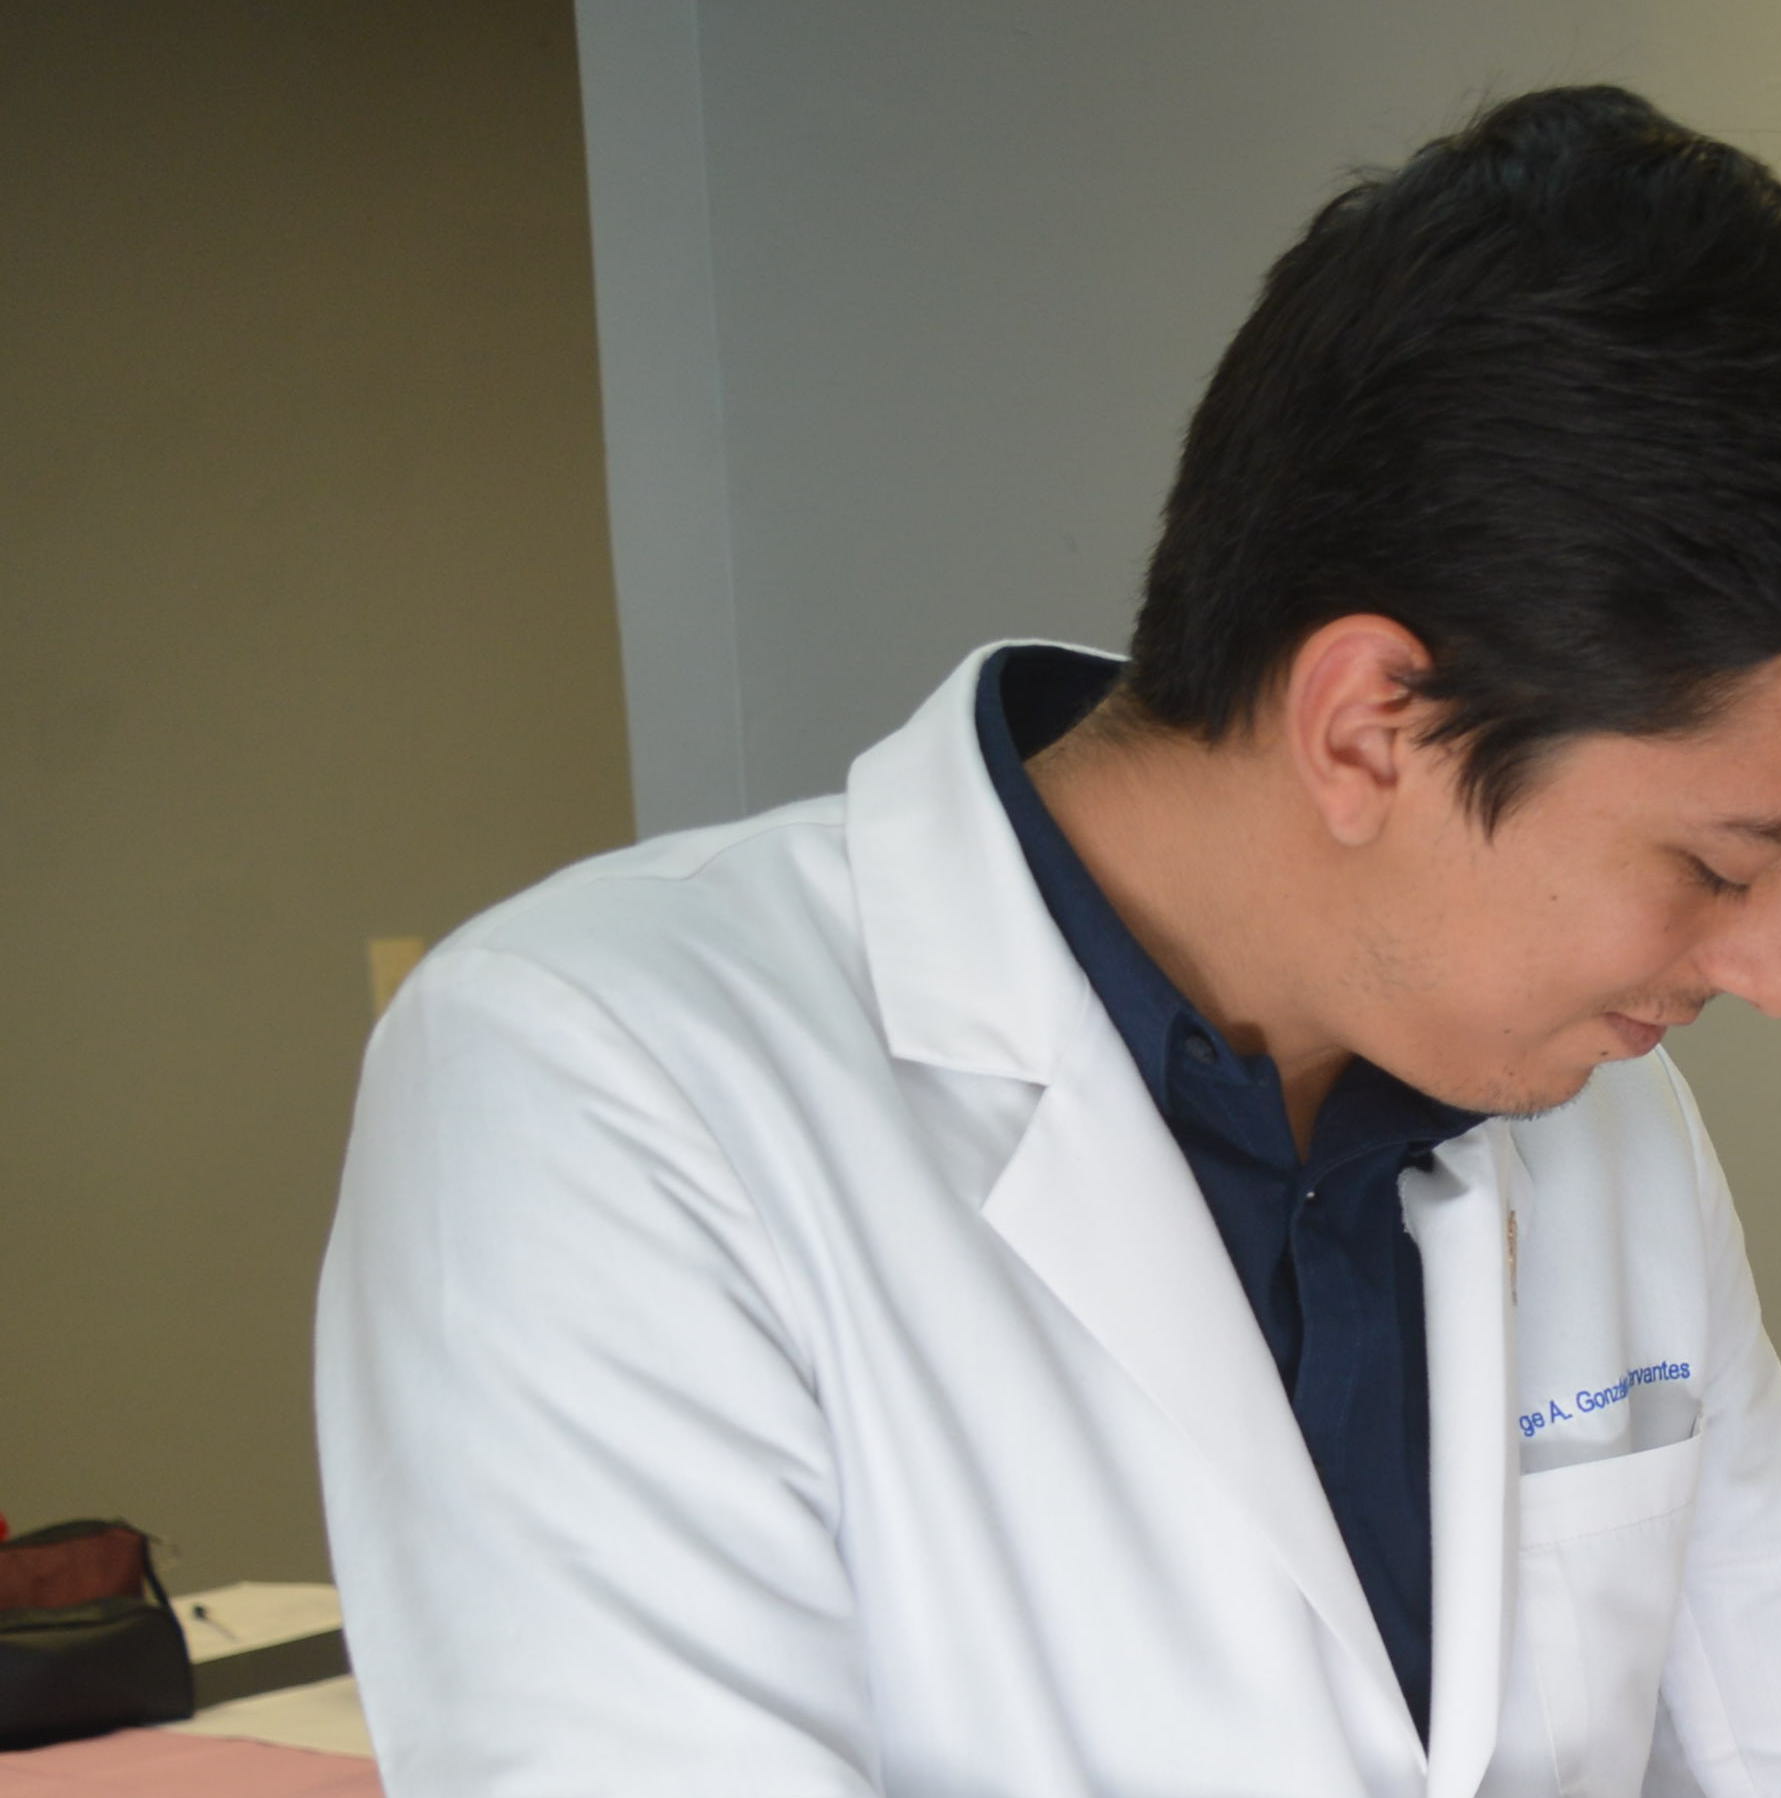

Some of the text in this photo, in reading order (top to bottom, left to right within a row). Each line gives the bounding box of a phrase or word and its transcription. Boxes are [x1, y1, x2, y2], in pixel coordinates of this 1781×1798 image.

[1519, 1412, 1545, 1437] ge
[1549, 1400, 1573, 1423] A.
[1627, 1360, 1691, 1387] rvantes
